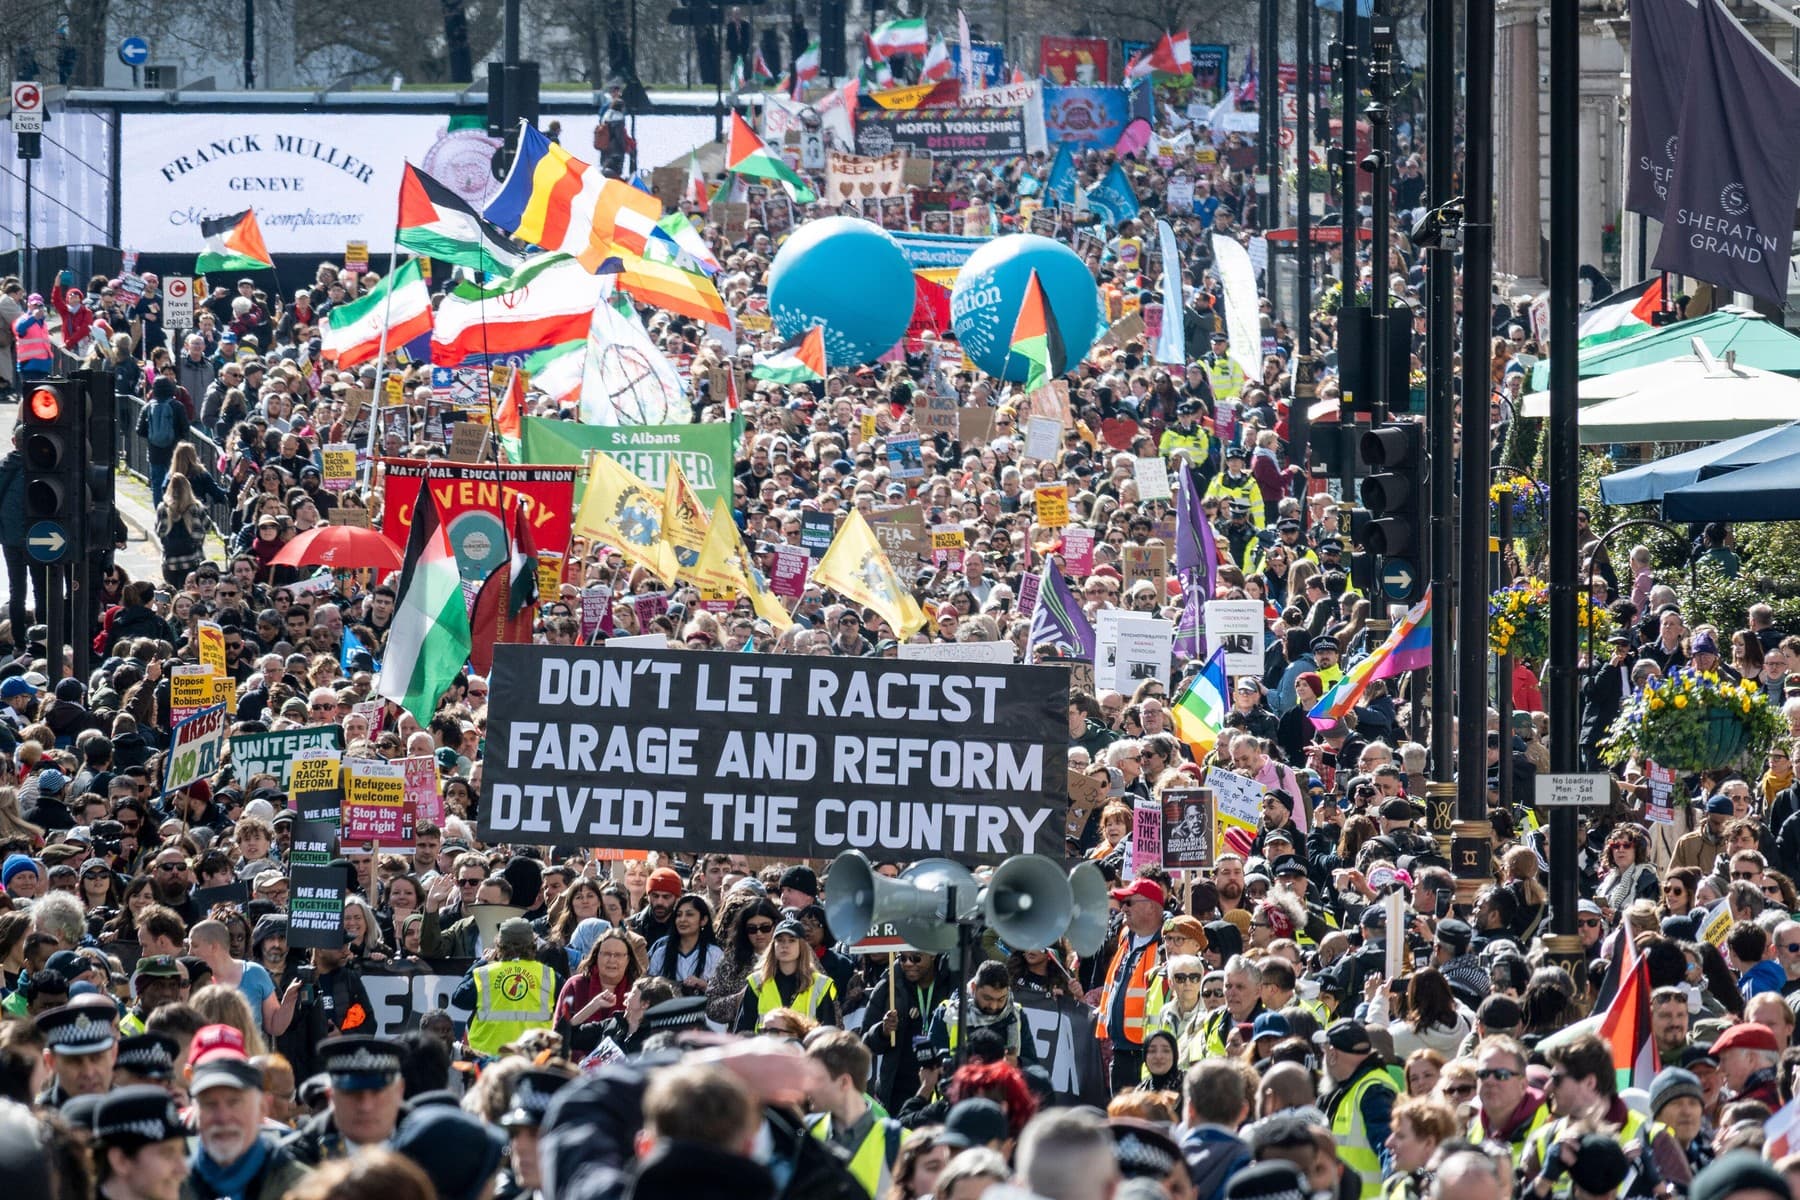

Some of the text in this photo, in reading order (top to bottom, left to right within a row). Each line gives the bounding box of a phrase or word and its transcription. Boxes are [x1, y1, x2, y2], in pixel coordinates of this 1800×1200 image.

[896, 121, 1022, 134] NORTH YORKSHIRE
[927, 136, 987, 148] DISTRICT
[160, 134, 374, 184] FRANCK MULLER
[228, 177, 305, 192] GENEVE
[1677, 209, 1777, 251] SHERATON
[1690, 233, 1762, 264] GRAND
[611, 432, 681, 445] St Albans
[461, 468, 527, 481] EDUCATION
[534, 471, 572, 481] UNION
[399, 481, 555, 529] CVENTRY
[877, 526, 916, 541] FEAR
[1132, 568, 1160, 577] HATE
[173, 677, 205, 687] Oppose
[214, 682, 233, 693] OFF
[174, 688, 203, 696] Tommy
[539, 657, 1007, 724] DON'T LET RACIST
[173, 696, 210, 705] Robinson
[507, 721, 1044, 792] FARAGE AND REFORM
[168, 749, 197, 788] NO
[302, 760, 328, 770] STOP
[296, 769, 332, 779] RACIST
[293, 779, 333, 789] REFORM
[354, 778, 402, 791] Refugees
[1566, 776, 1594, 785] loading
[354, 791, 399, 802] welcome
[304, 807, 340, 819] WE ARE
[353, 807, 397, 819] Stop the
[490, 783, 1053, 855] DIVIDE THE COUNTRY
[352, 820, 395, 833] far right
[1138, 825, 1155, 839] THE
[294, 840, 327, 851] WE ARE
[1137, 839, 1160, 854] RIGH
[291, 852, 329, 862] TOGETHER
[297, 887, 338, 898] WE ARE
[294, 900, 340, 910] TOGETHER
[292, 910, 340, 920] AGAINST THE
[291, 919, 340, 931] FAR RIGHT
